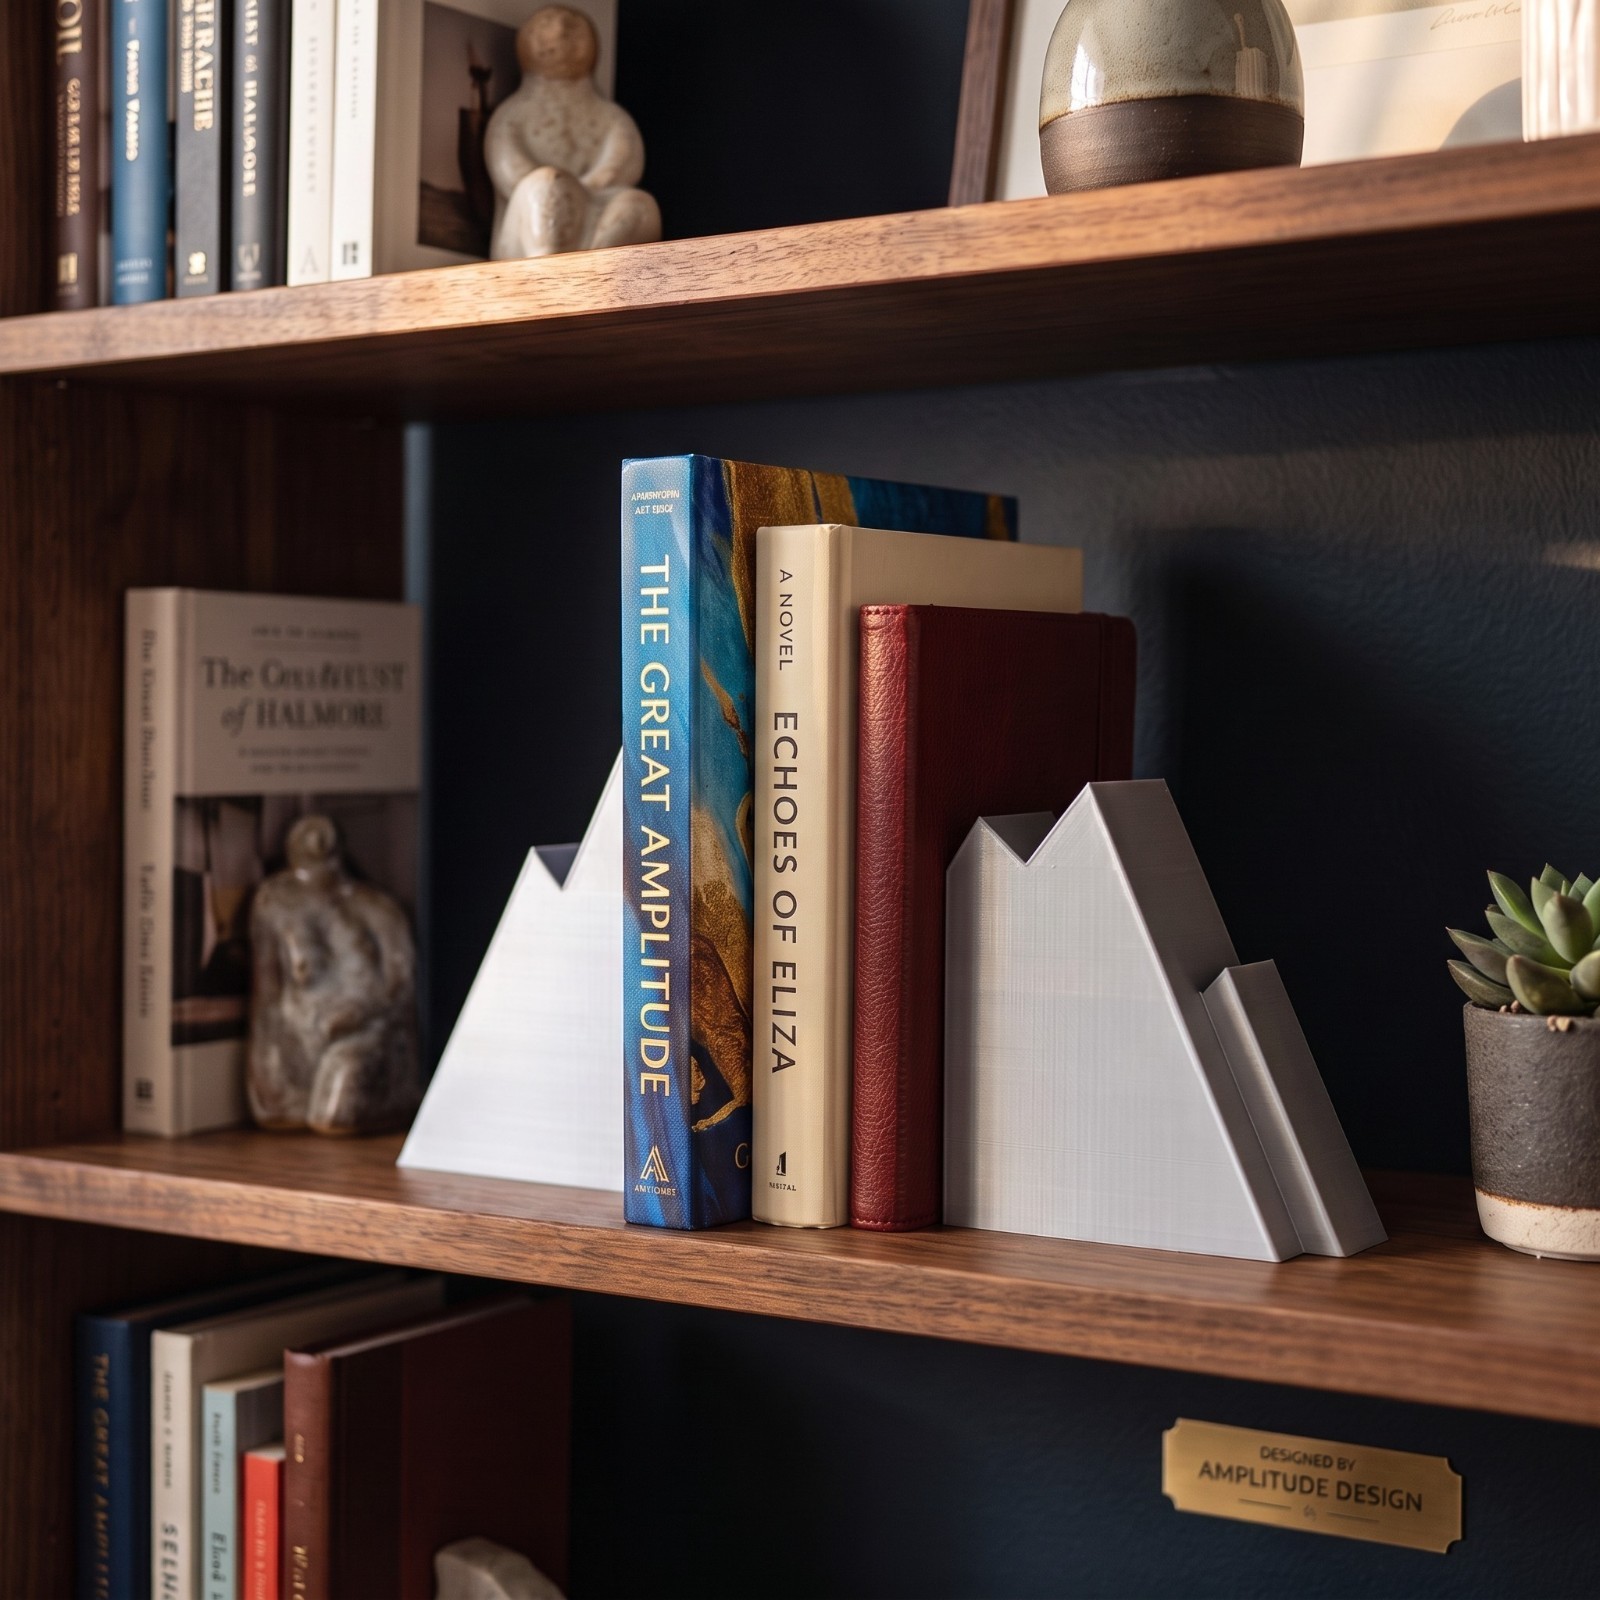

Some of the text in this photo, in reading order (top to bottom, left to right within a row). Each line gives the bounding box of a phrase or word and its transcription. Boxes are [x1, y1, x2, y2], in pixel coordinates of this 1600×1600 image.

[779, 569, 793, 671] A NOVEL
[640, 554, 670, 1096] THE GREAT AMPLITUDE
[771, 712, 798, 1073] ECHOES OF ELIZA
[1198, 1460, 1422, 1512] AMPLITUDE DESIGN
[1260, 1446, 1357, 1471] DESIGNED BY
